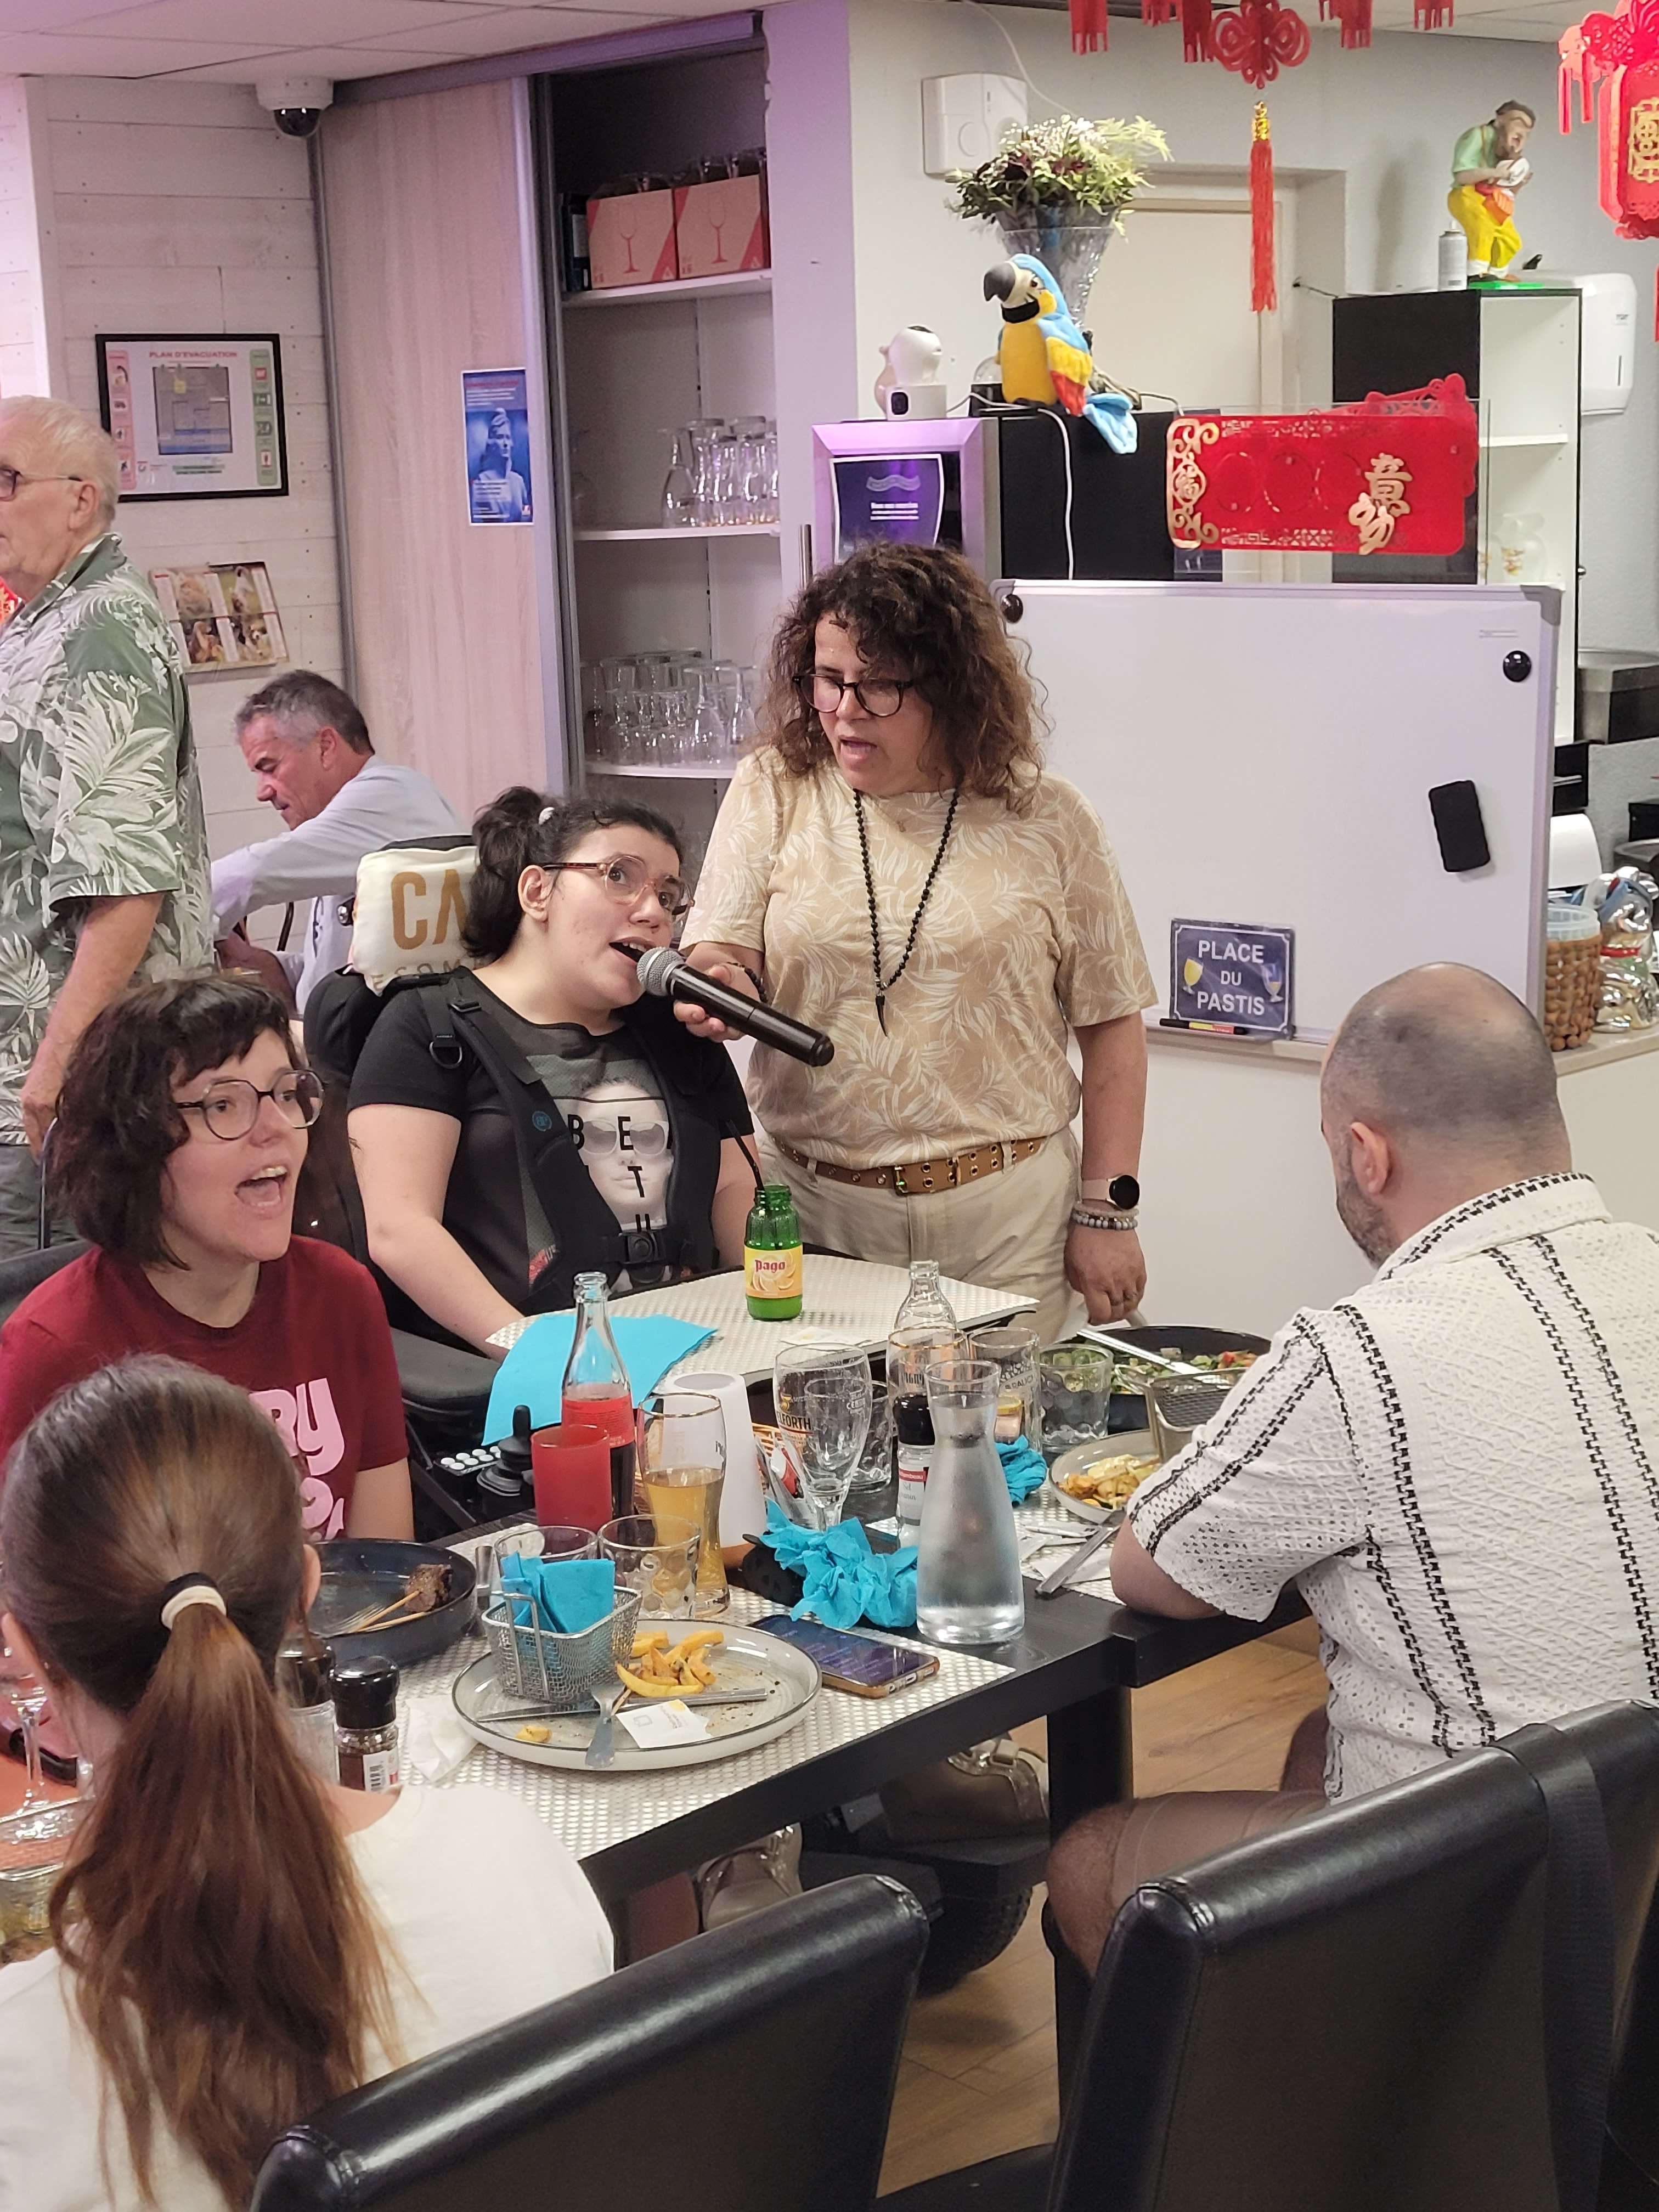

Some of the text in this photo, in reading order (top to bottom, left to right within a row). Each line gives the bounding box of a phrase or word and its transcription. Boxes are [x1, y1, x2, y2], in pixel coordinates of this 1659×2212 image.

[1198, 940, 1265, 963] PLACE
[1220, 970, 1242, 986] DU
[1197, 991, 1265, 1015] PASTIS
